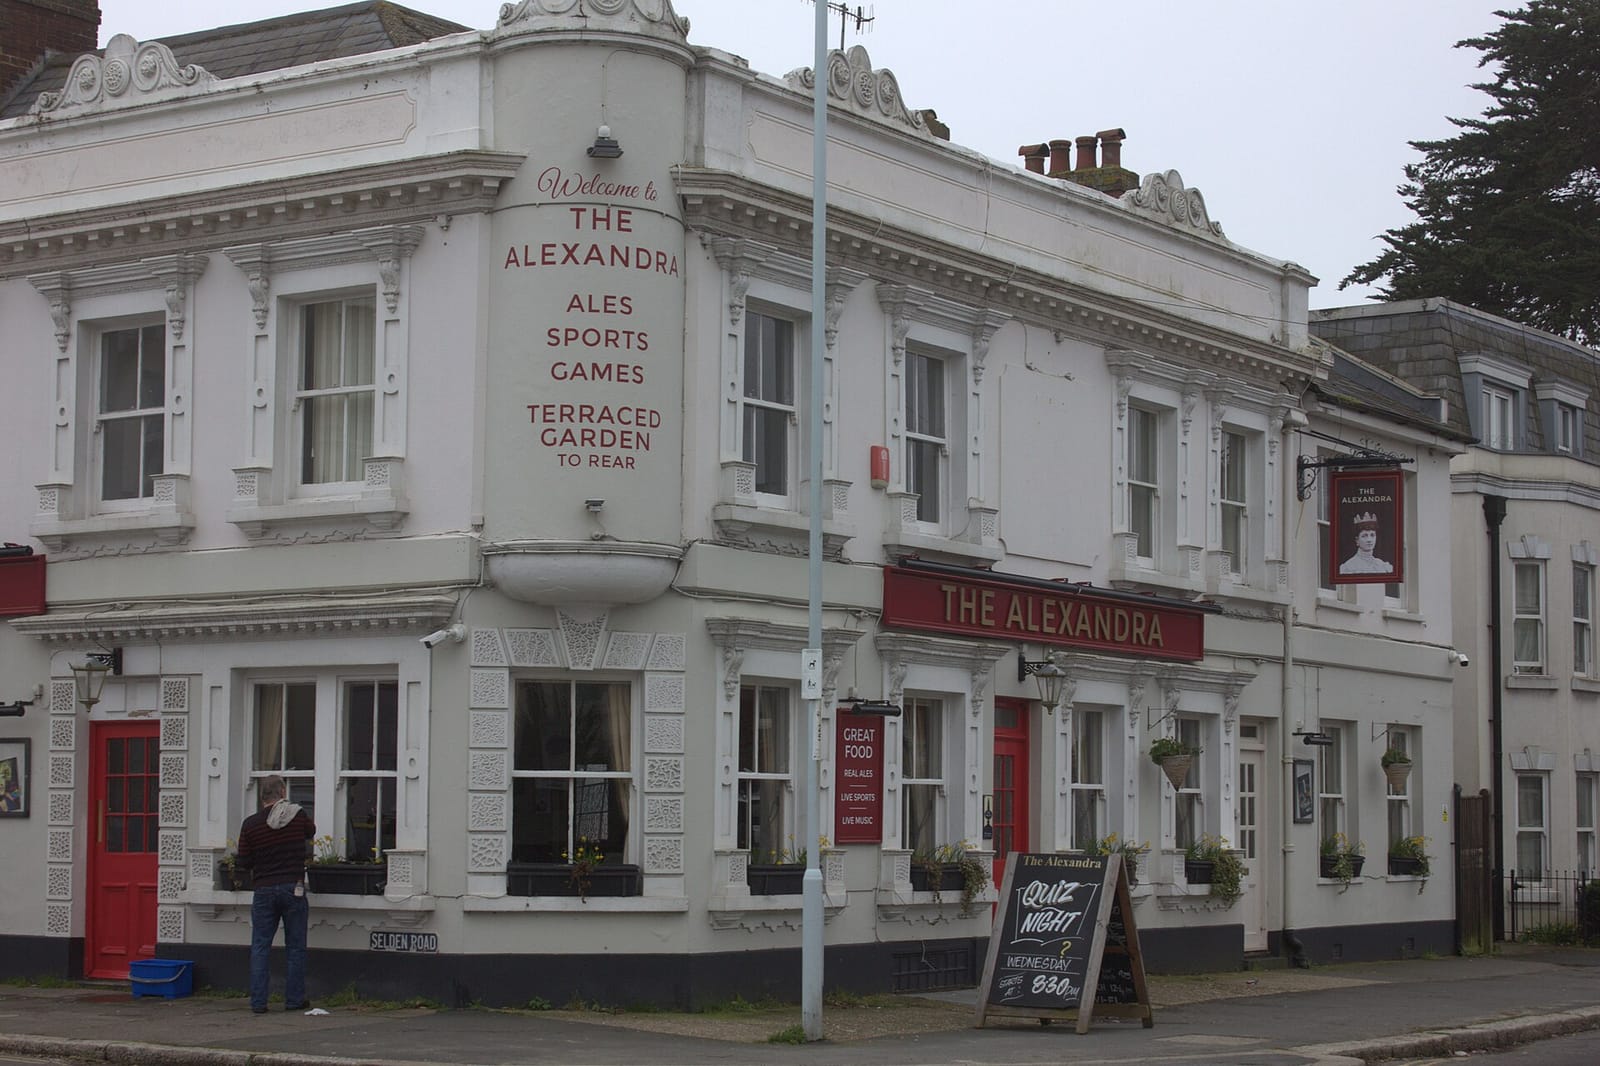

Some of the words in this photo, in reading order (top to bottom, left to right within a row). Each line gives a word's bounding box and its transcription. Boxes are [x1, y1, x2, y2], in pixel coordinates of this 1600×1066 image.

[538, 166, 640, 200] Welcome
[645, 179, 658, 201] to
[570, 207, 632, 233] THE
[504, 243, 679, 278] ALEXANDRA
[566, 294, 633, 315] ALES
[547, 328, 648, 351] SPORTS
[551, 362, 644, 384] GAMES
[527, 404, 661, 429] TERRACED
[541, 428, 650, 451] GARDEN
[557, 454, 582, 467] TO
[589, 455, 635, 470] REAR
[1341, 495, 1392, 504] ALEXANDRA
[941, 584, 996, 627] THE
[1006, 595, 1164, 648] ALEXANDRA
[843, 728, 875, 742] GREAT
[845, 745, 873, 759] FOOD
[844, 769, 858, 778] REAL
[859, 769, 873, 778] ALES
[841, 793, 853, 801] LIVE
[854, 793, 875, 802] SPORTS
[842, 816, 854, 825] LIVE
[855, 816, 873, 825] MUSIC
[1023, 855, 1042, 867] The
[1044, 856, 1101, 869] Alexandra
[1020, 907, 1082, 934] NIGHT
[371, 933, 408, 950] SELDEN
[410, 934, 436, 951] ROAD
[1007, 955, 1072, 972] WEDNESDAY
